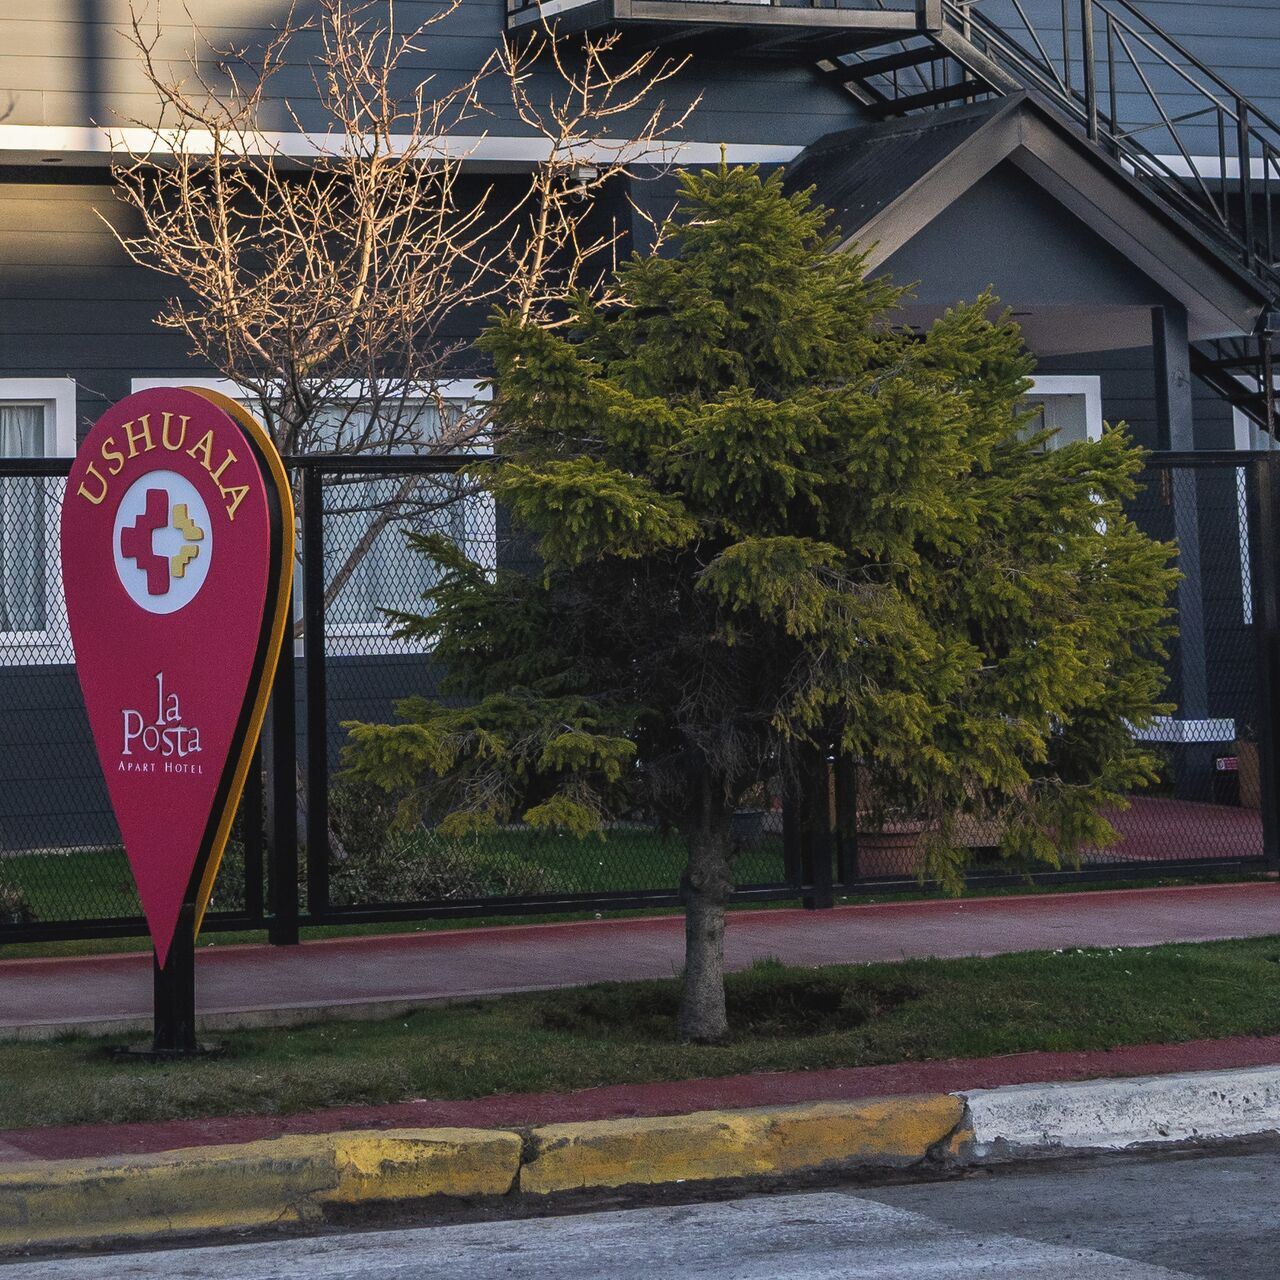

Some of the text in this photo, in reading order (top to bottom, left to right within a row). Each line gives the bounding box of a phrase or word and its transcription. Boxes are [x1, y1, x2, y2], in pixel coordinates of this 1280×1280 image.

[77, 412, 250, 521] USHUAIA
[156, 672, 182, 725] la
[122, 709, 202, 757] Posta
[118, 761, 202, 774] APART HOTEL
